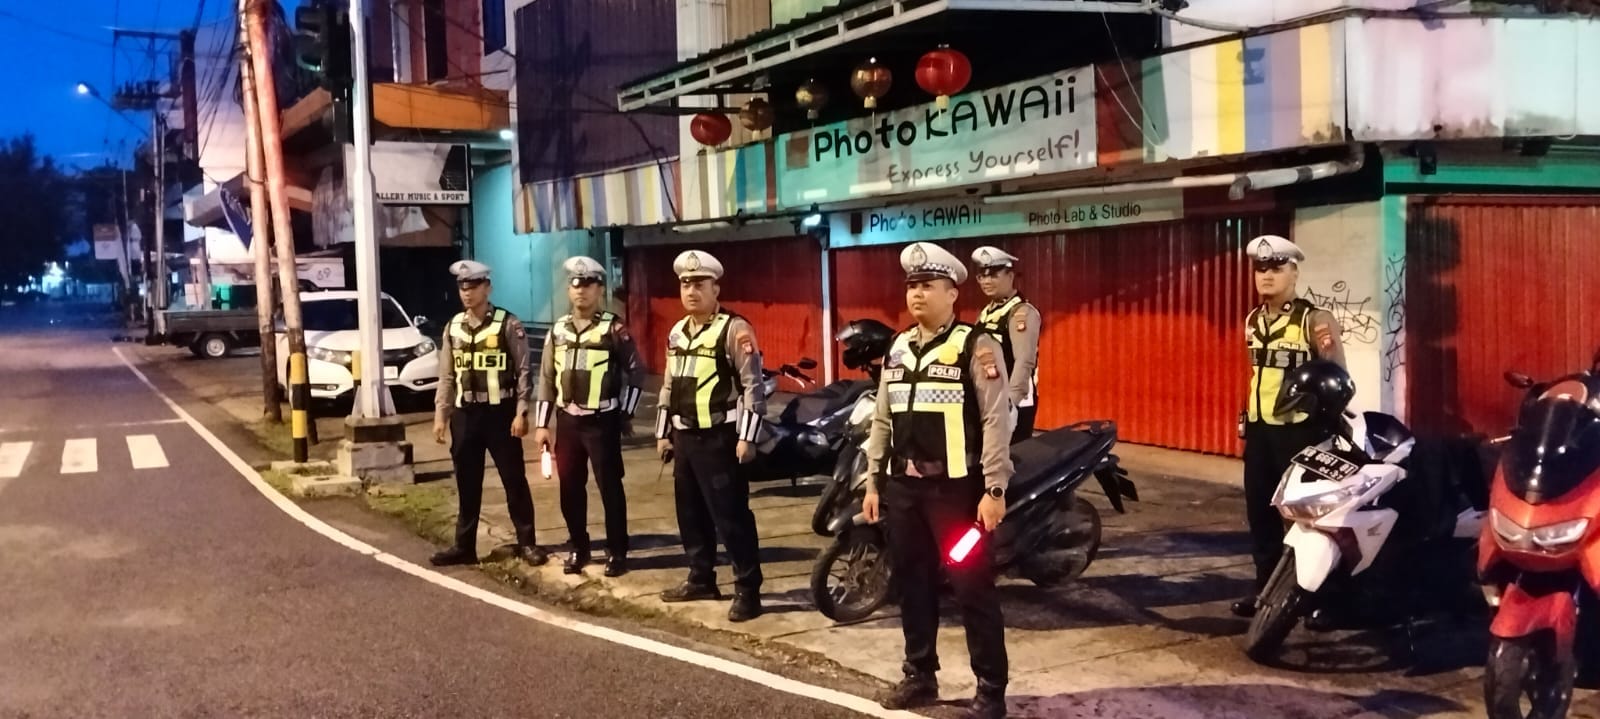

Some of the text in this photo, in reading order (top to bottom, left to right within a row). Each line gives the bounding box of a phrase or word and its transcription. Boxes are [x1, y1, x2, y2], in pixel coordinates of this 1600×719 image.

[814, 75, 1076, 162] Photo KAWAii
[886, 129, 1081, 186] Express Yourself!
[375, 192, 405, 201] ALLERY
[408, 192, 431, 201] MUSIC
[441, 193, 465, 201] SPORT
[923, 204, 982, 228] KAWAii
[1028, 203, 1141, 227] Photo Lab & Studio
[930, 367, 958, 377] POLRI
